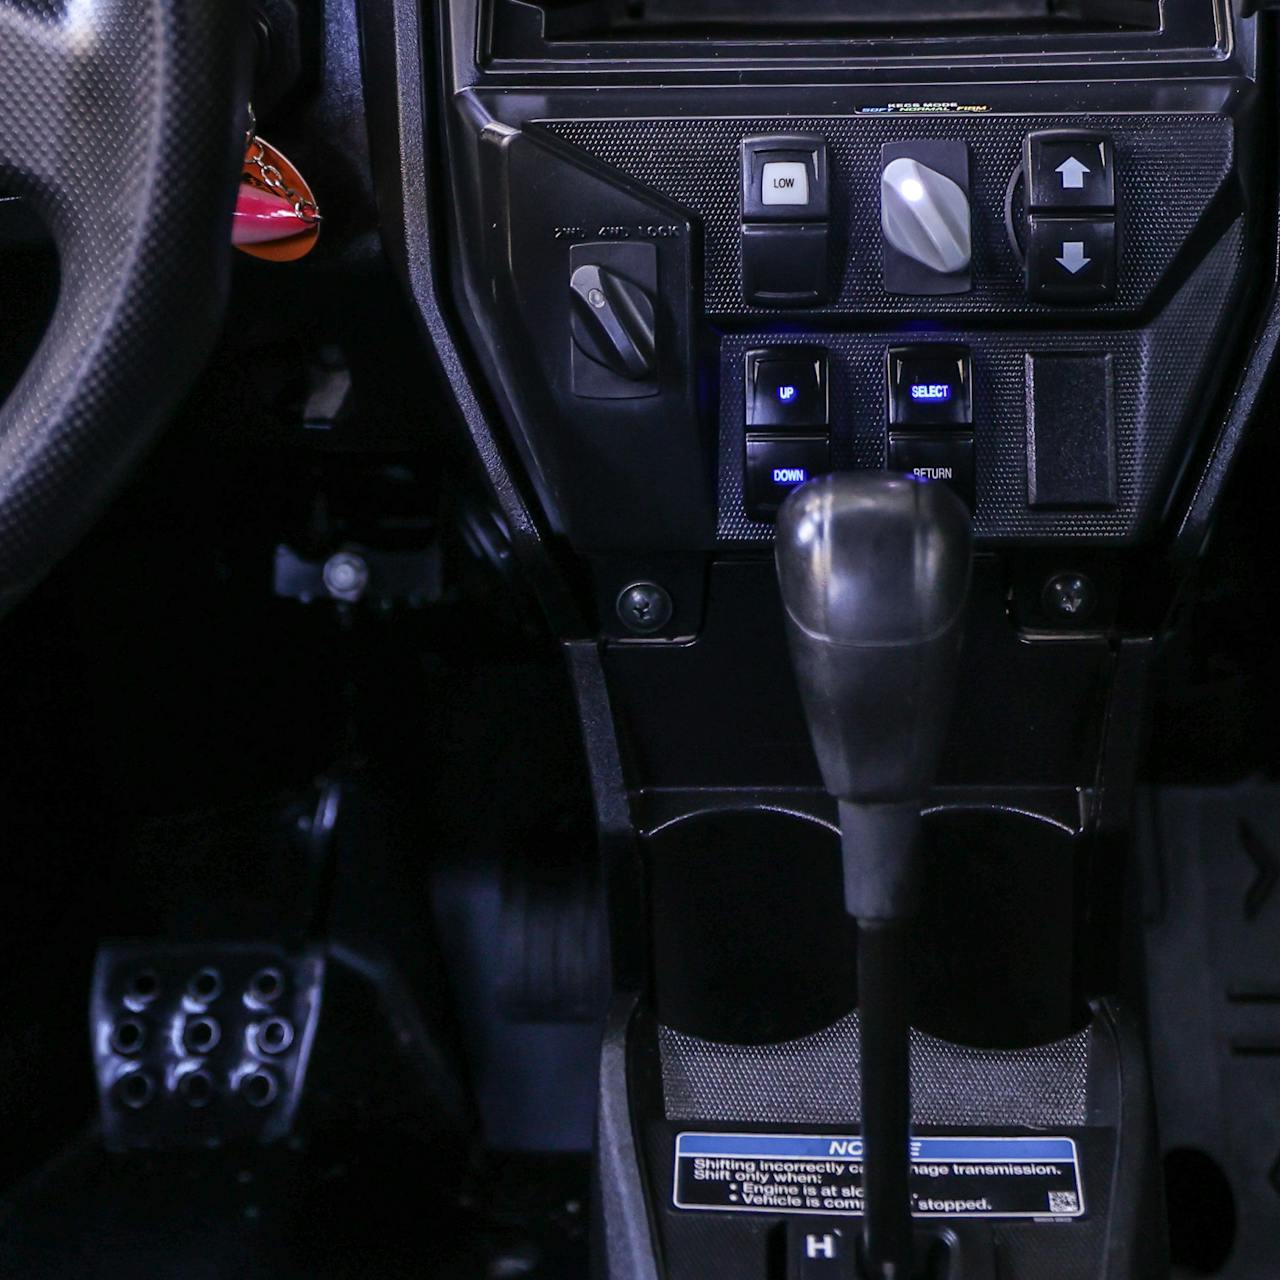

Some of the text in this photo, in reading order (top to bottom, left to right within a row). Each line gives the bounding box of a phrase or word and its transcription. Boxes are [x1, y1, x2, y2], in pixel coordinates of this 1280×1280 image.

[772, 177, 795, 189] LOW
[638, 225, 680, 237] LOCK
[779, 386, 794, 399] UP
[911, 385, 949, 398] SELECT
[773, 469, 804, 482] DOWN
[913, 467, 952, 480] RETURN
[694, 1158, 755, 1172] Shifting
[760, 1160, 845, 1176] incorrectly
[953, 1163, 1062, 1175] transmission.
[694, 1169, 823, 1184] Shift only when:
[742, 1182, 799, 1196] Engine
[803, 1185, 817, 1196] is
[821, 1185, 838, 1197] at
[742, 1193, 802, 1207] Vehicle
[806, 1196, 820, 1208] is
[918, 1197, 992, 1213] stopped.
[805, 1234, 835, 1258] H
